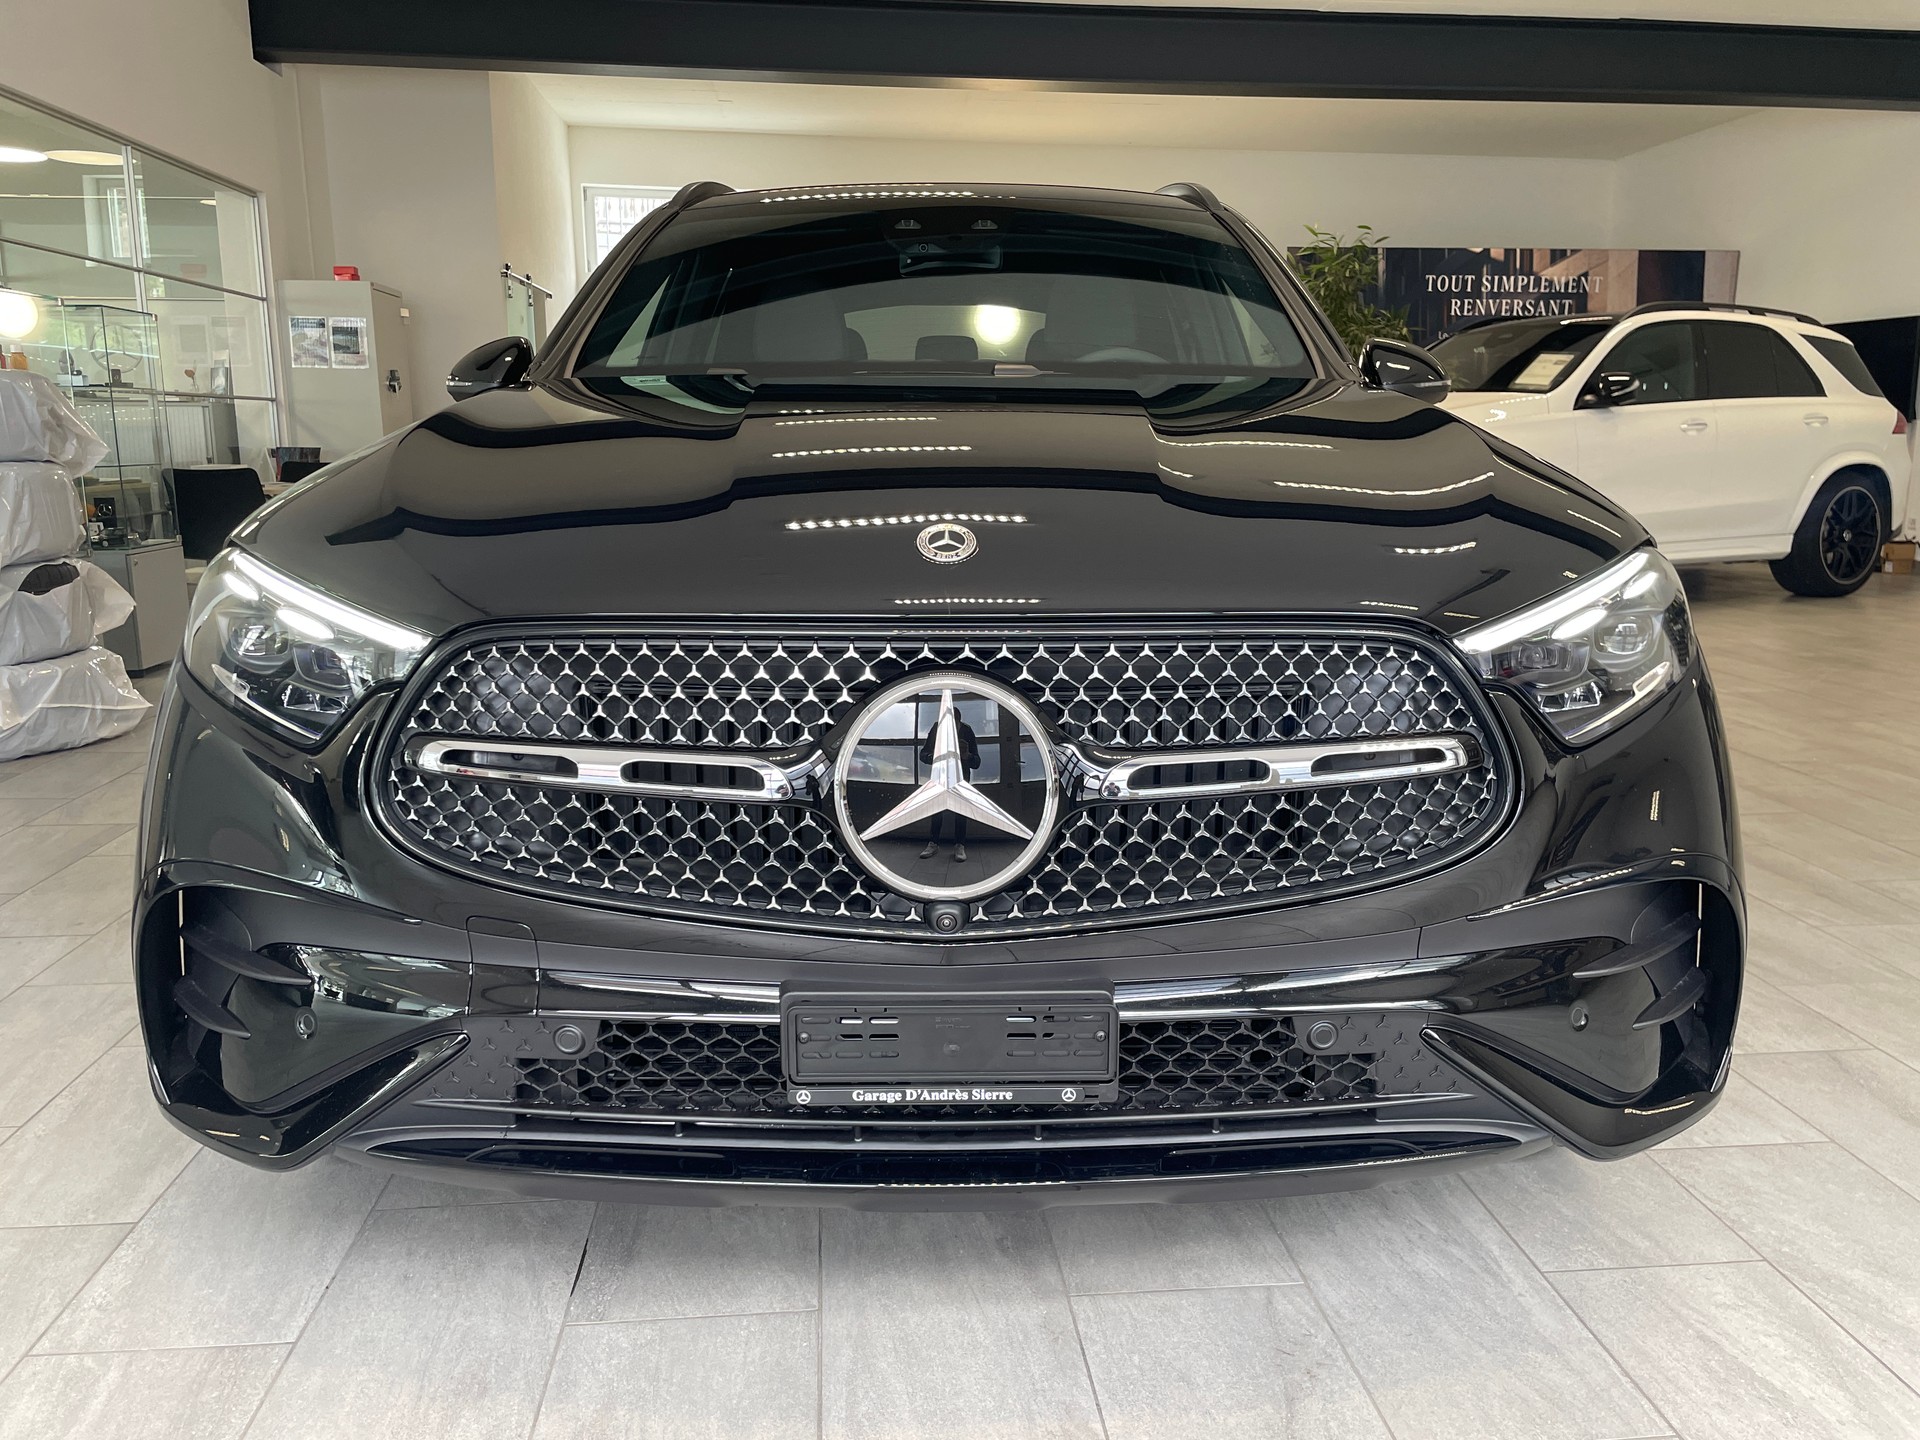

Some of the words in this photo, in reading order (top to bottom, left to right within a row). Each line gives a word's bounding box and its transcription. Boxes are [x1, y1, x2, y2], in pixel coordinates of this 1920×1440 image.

[1425, 274, 1476, 293] TOUT
[1481, 275, 1603, 294] SIMPLEMENT
[852, 1089, 902, 1103] Garage
[905, 1088, 969, 1101] D'Andrès
[971, 1088, 1013, 1101] Sierre
